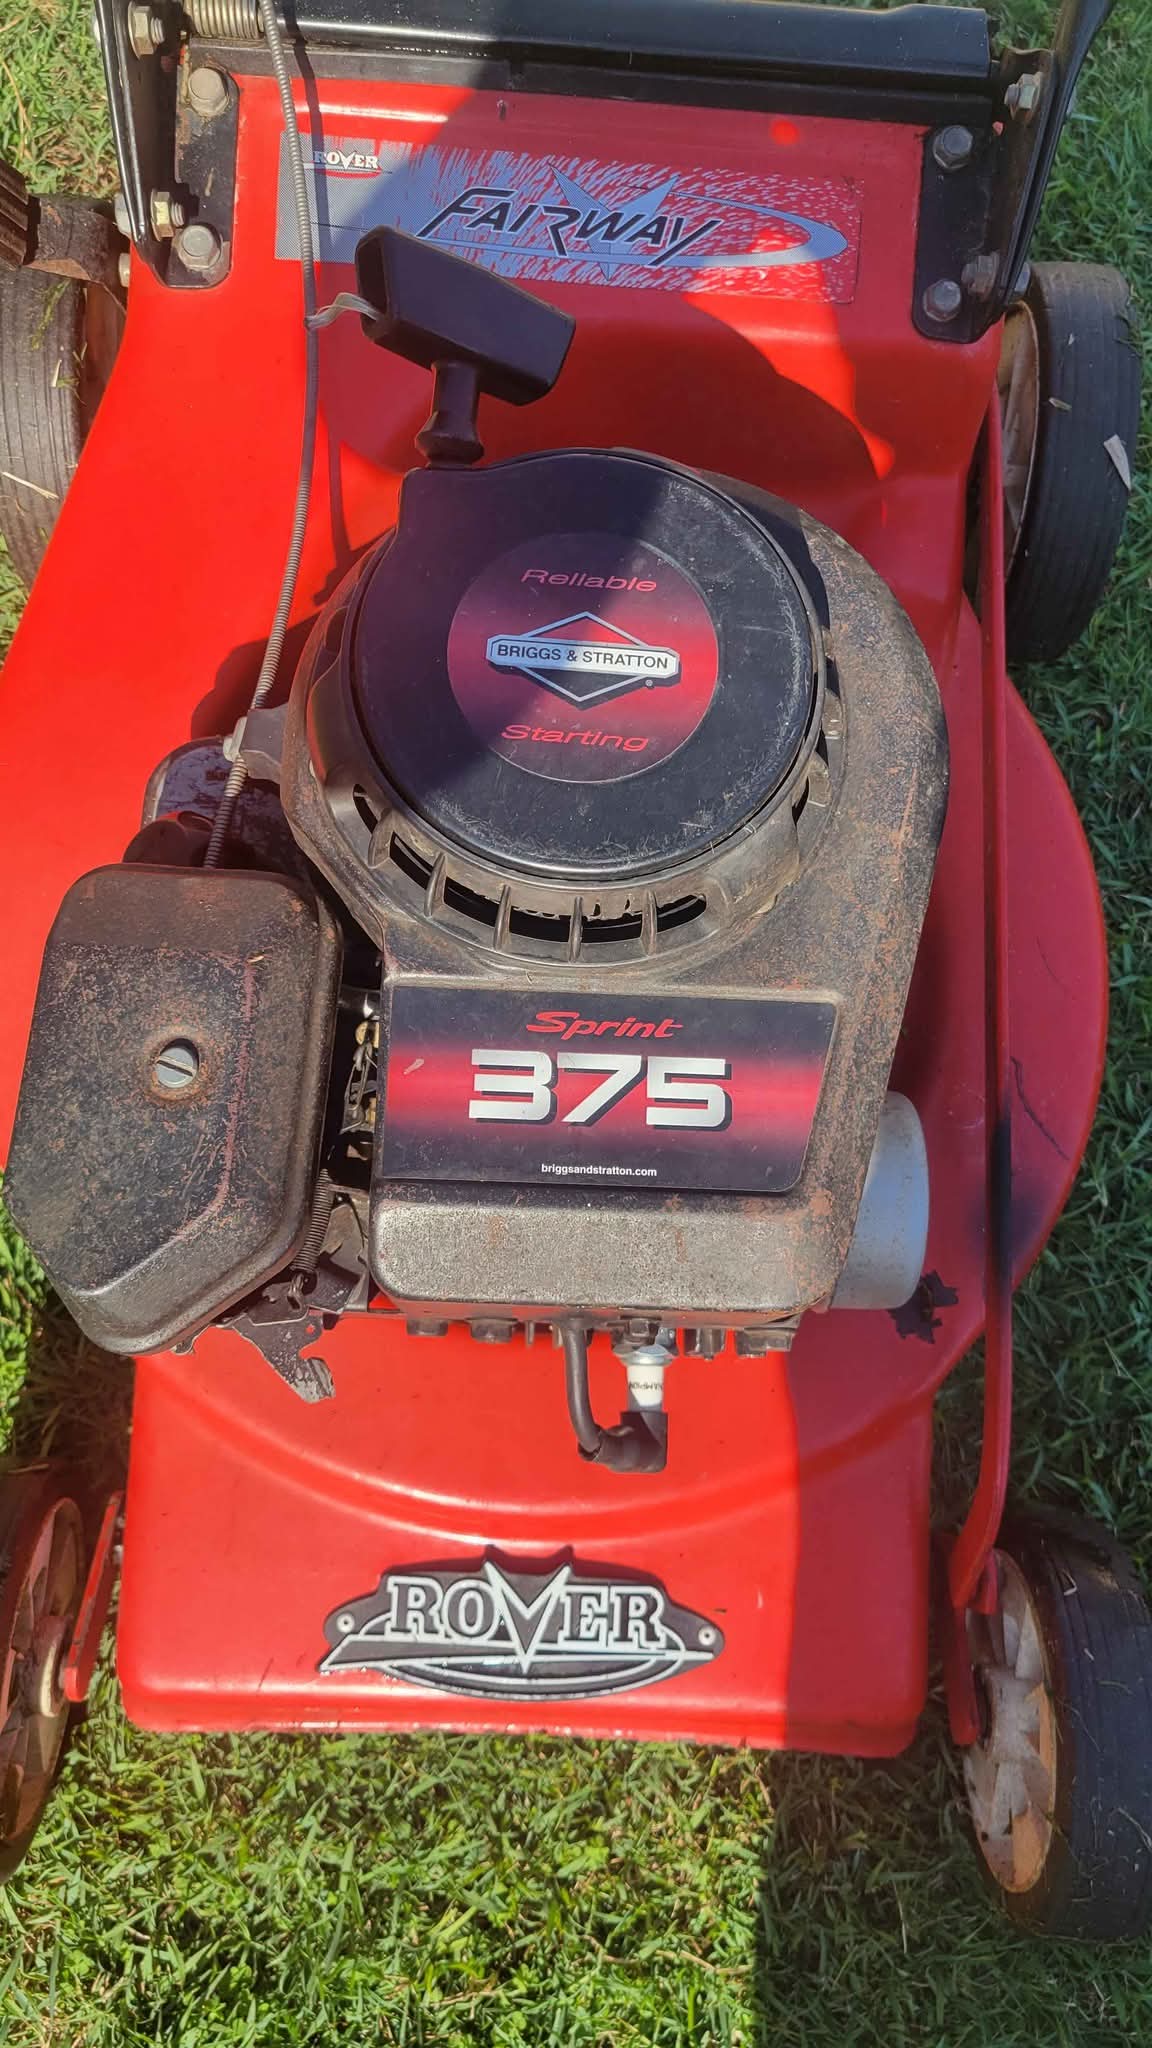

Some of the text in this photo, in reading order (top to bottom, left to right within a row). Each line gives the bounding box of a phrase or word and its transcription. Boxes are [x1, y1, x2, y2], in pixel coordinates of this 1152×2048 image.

[313, 150, 379, 169] ROVER
[414, 186, 721, 267] FAIRWAY
[520, 569, 657, 592] Reliable
[497, 644, 668, 669] BRIGGS & STRATTON
[501, 724, 649, 752] Starting
[526, 1011, 683, 1040] Sprint
[468, 1048, 730, 1130] 375
[541, 1163, 657, 1177] briggsandstratton.com
[387, 1561, 666, 1674] ROVER
